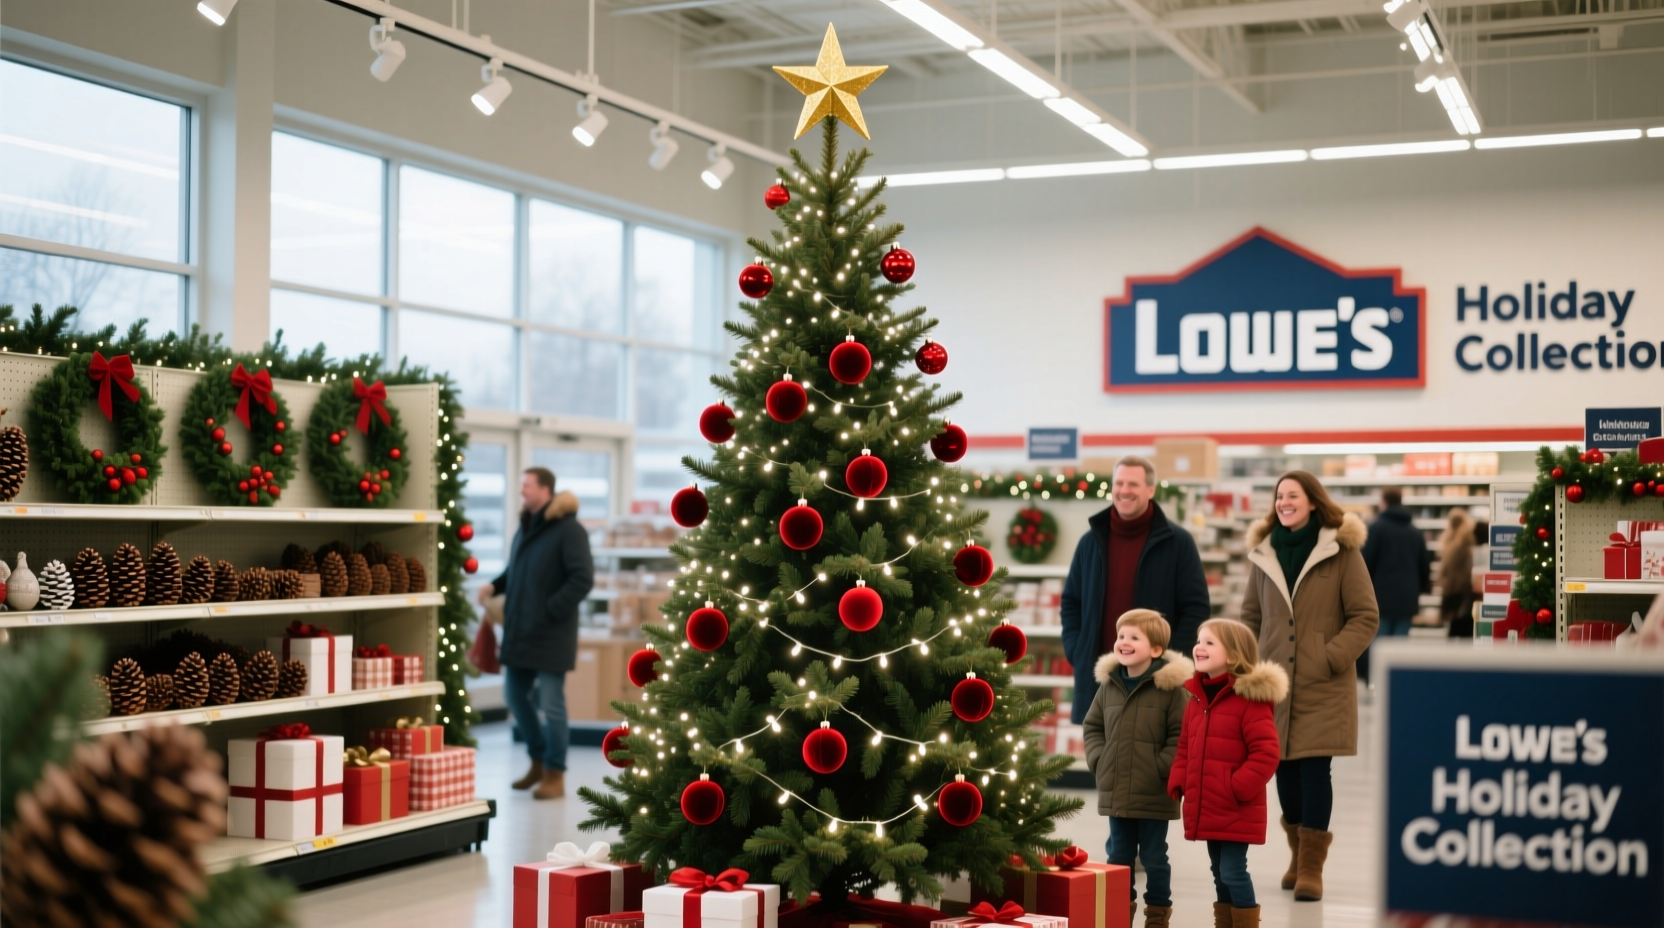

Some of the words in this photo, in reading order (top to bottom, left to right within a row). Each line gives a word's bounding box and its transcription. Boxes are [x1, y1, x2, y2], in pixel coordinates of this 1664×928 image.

[1456, 280, 1636, 329] Holiday
[1135, 296, 1393, 375] LOWE'S
[1455, 330, 1664, 373] Collectio
[1432, 766, 1621, 834] Holiday
[1401, 816, 1649, 877] Collection
